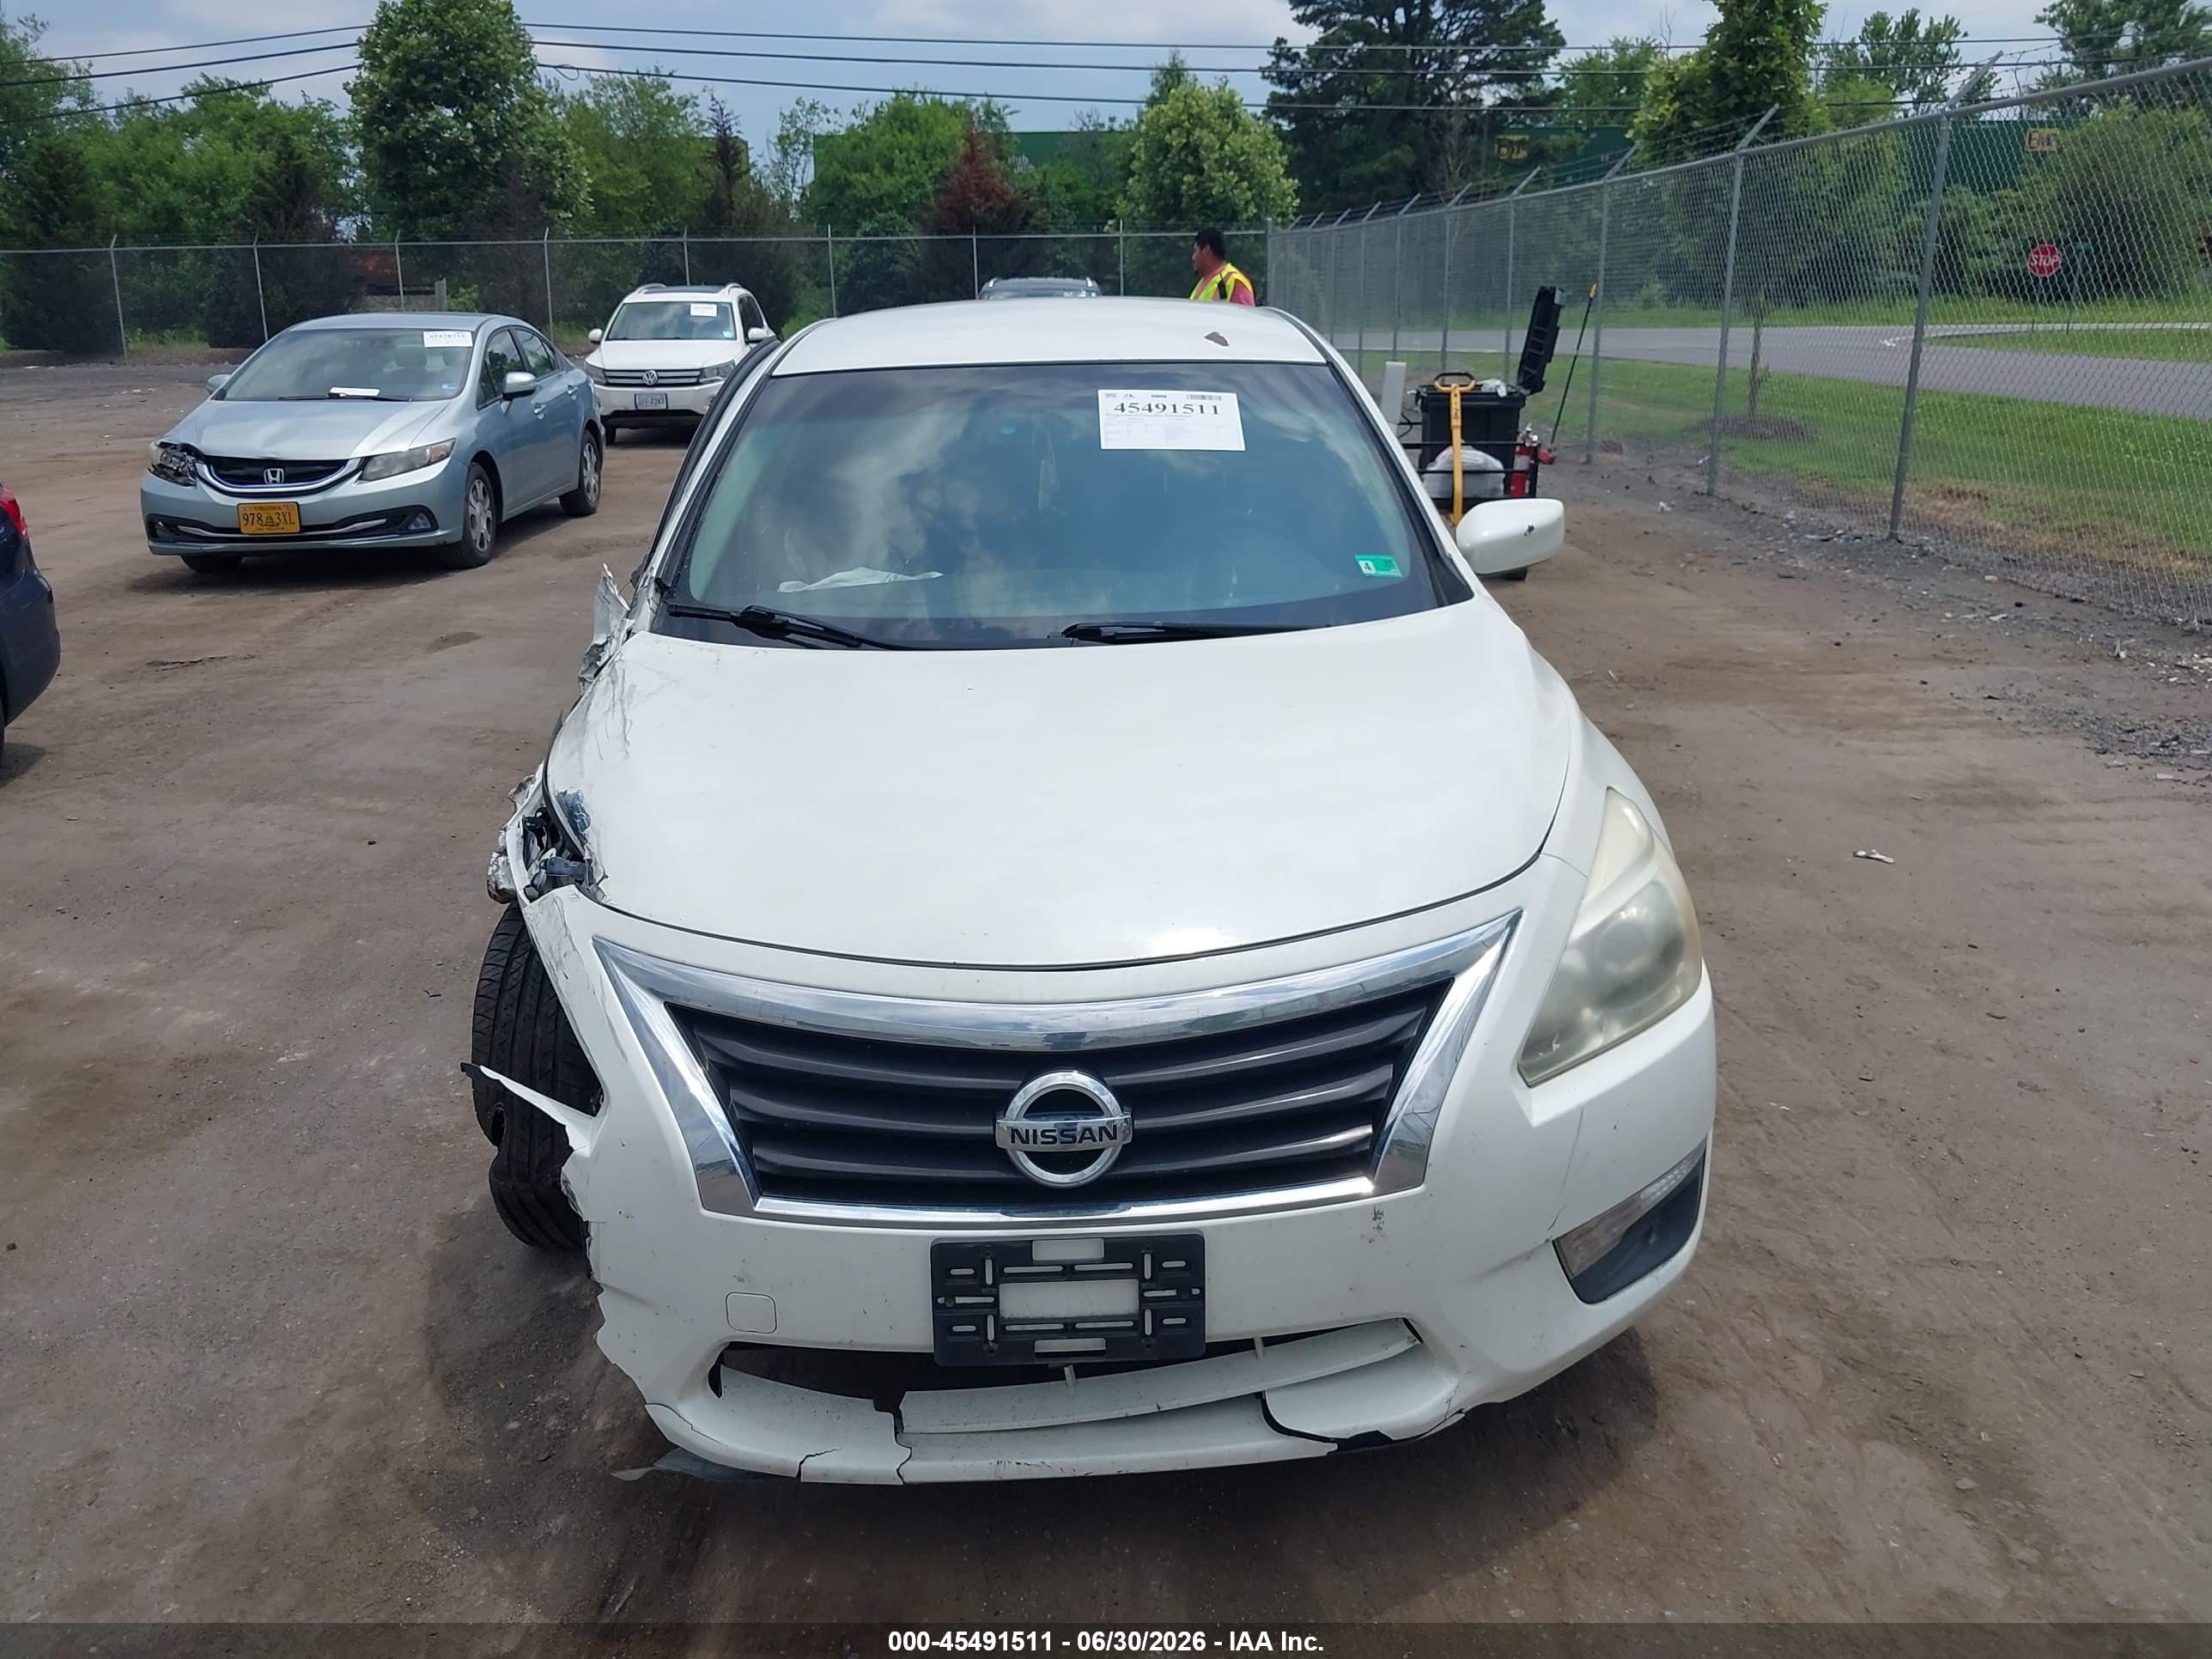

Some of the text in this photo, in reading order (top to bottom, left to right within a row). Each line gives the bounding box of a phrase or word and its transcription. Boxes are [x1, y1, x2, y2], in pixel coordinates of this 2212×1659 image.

[2031, 254, 2060, 266] STOP
[1114, 402, 1219, 415] 45491511
[243, 512, 295, 526] 978 3XL
[1011, 1125, 1117, 1146] NISSAN
